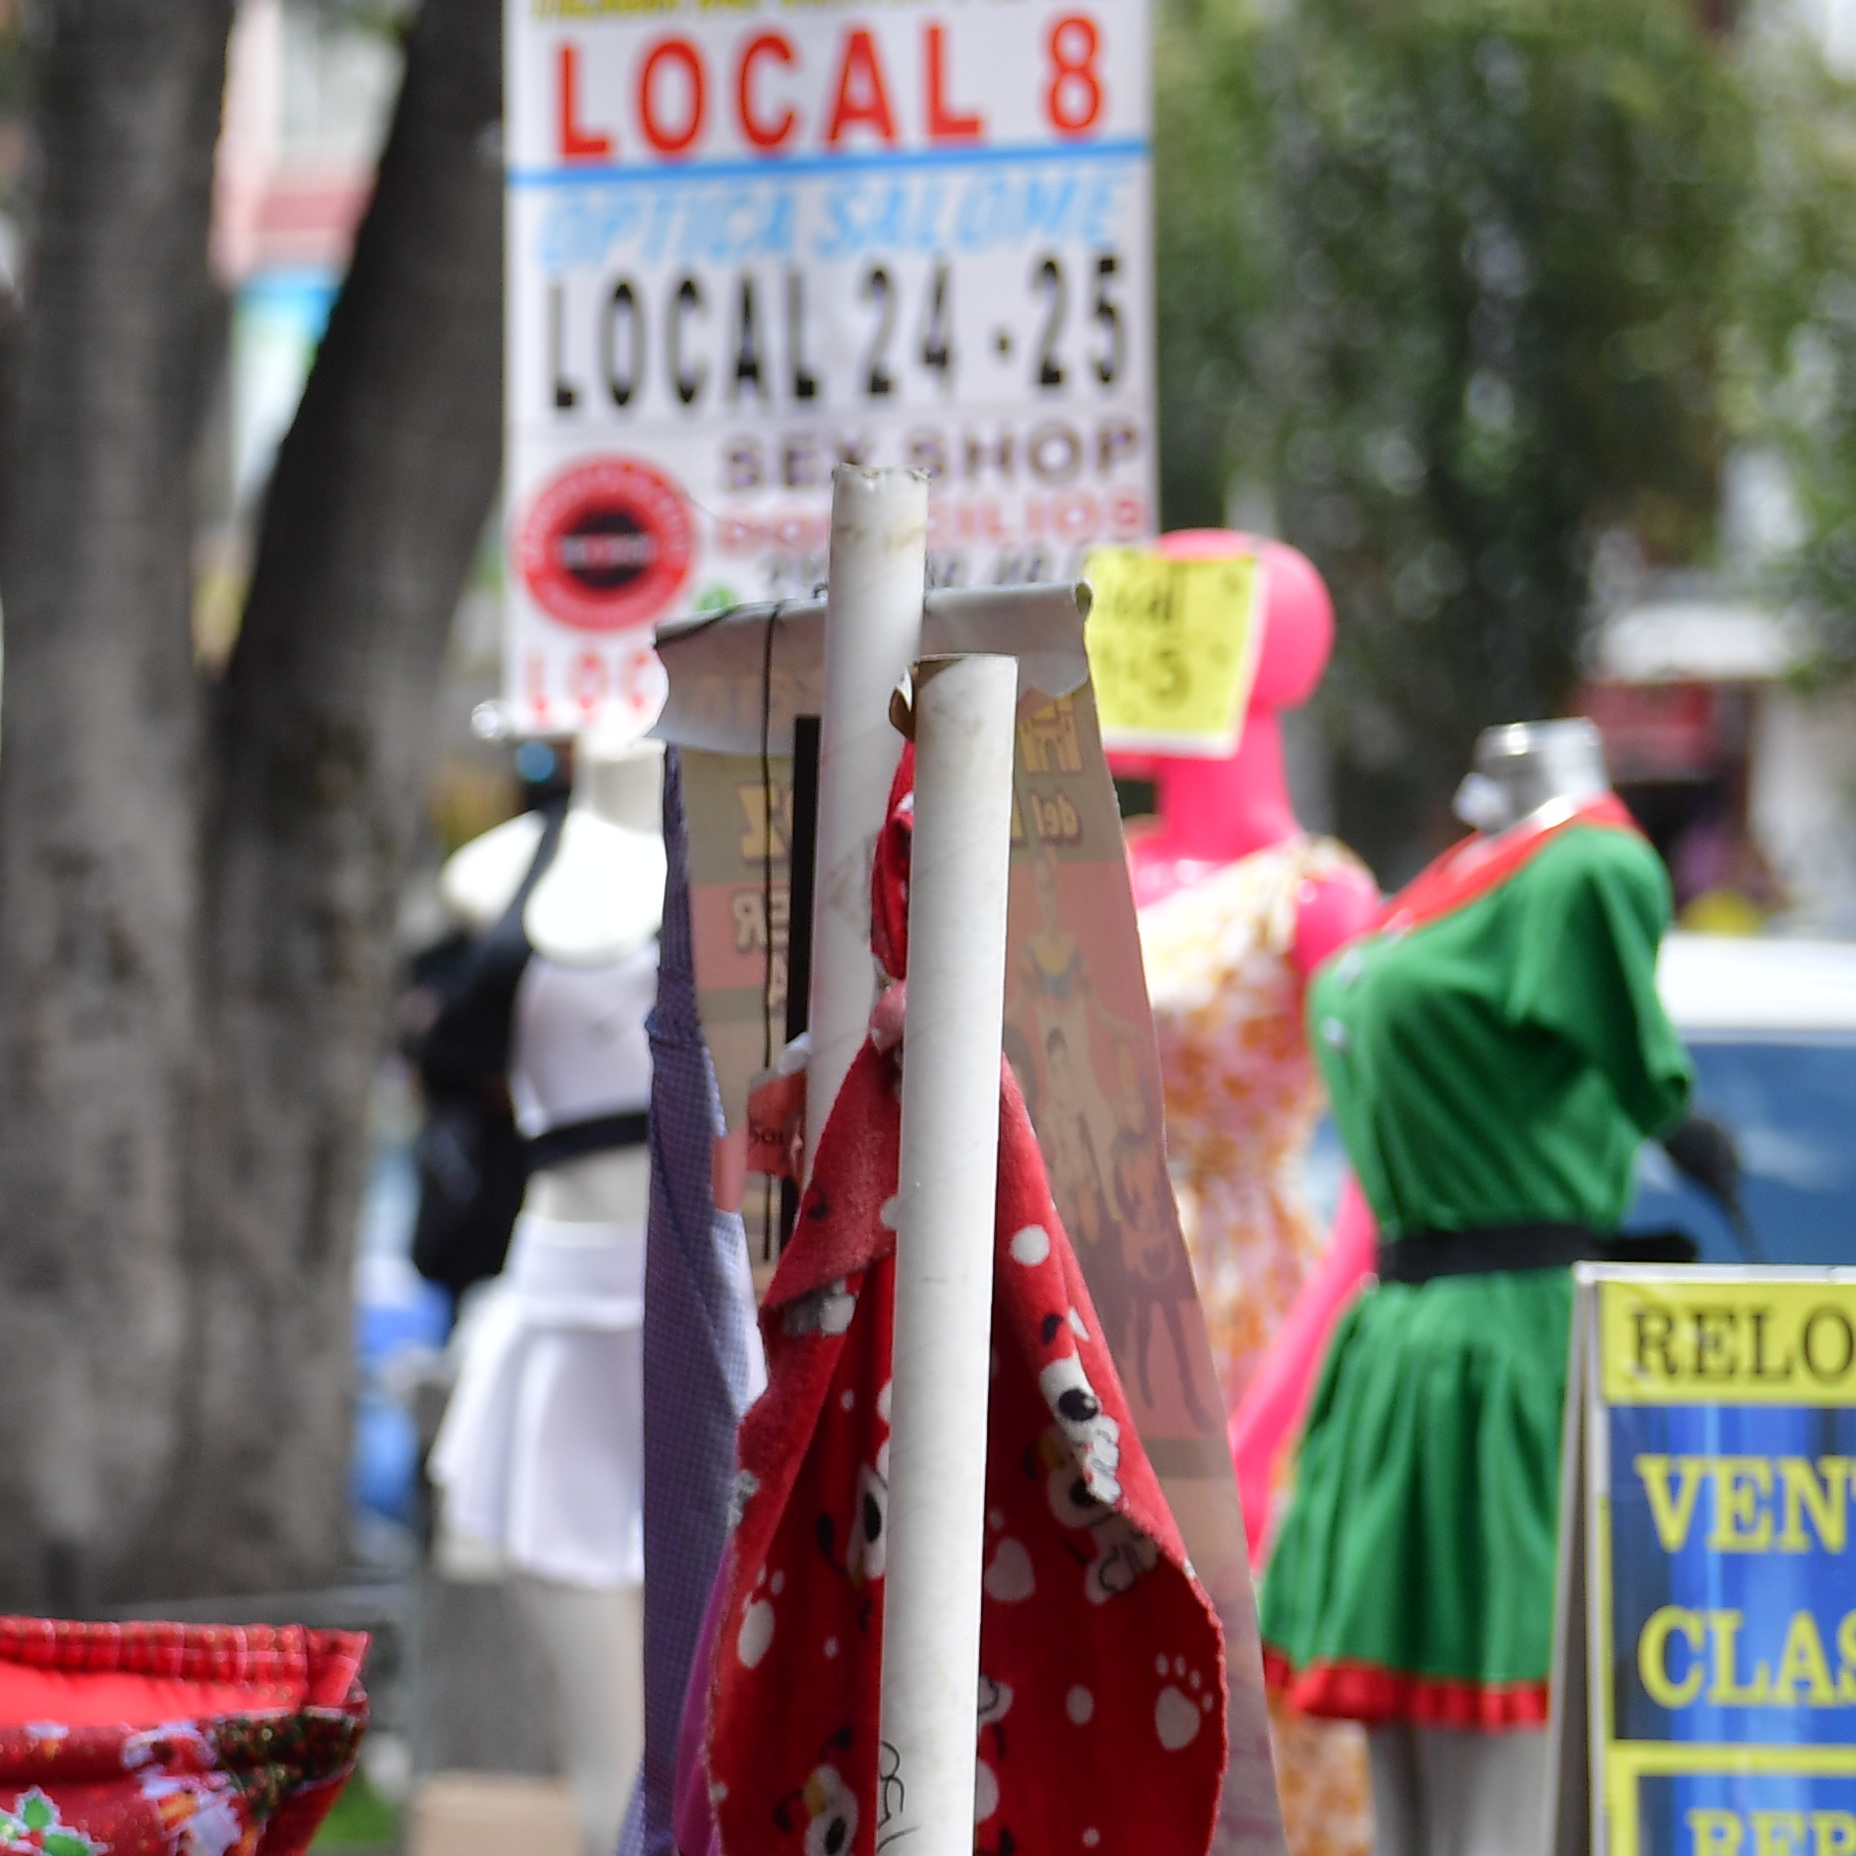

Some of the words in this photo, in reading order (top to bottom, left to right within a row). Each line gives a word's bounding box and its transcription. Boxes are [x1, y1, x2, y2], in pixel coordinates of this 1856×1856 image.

[554, 22, 985, 163] LOCAL
[1041, 11, 1108, 139] 8
[548, 272, 830, 412] LOCAL
[905, 418, 1140, 488] SHOP
[1629, 1303, 1856, 1385] RELO
[1634, 1452, 1856, 1555] VEN
